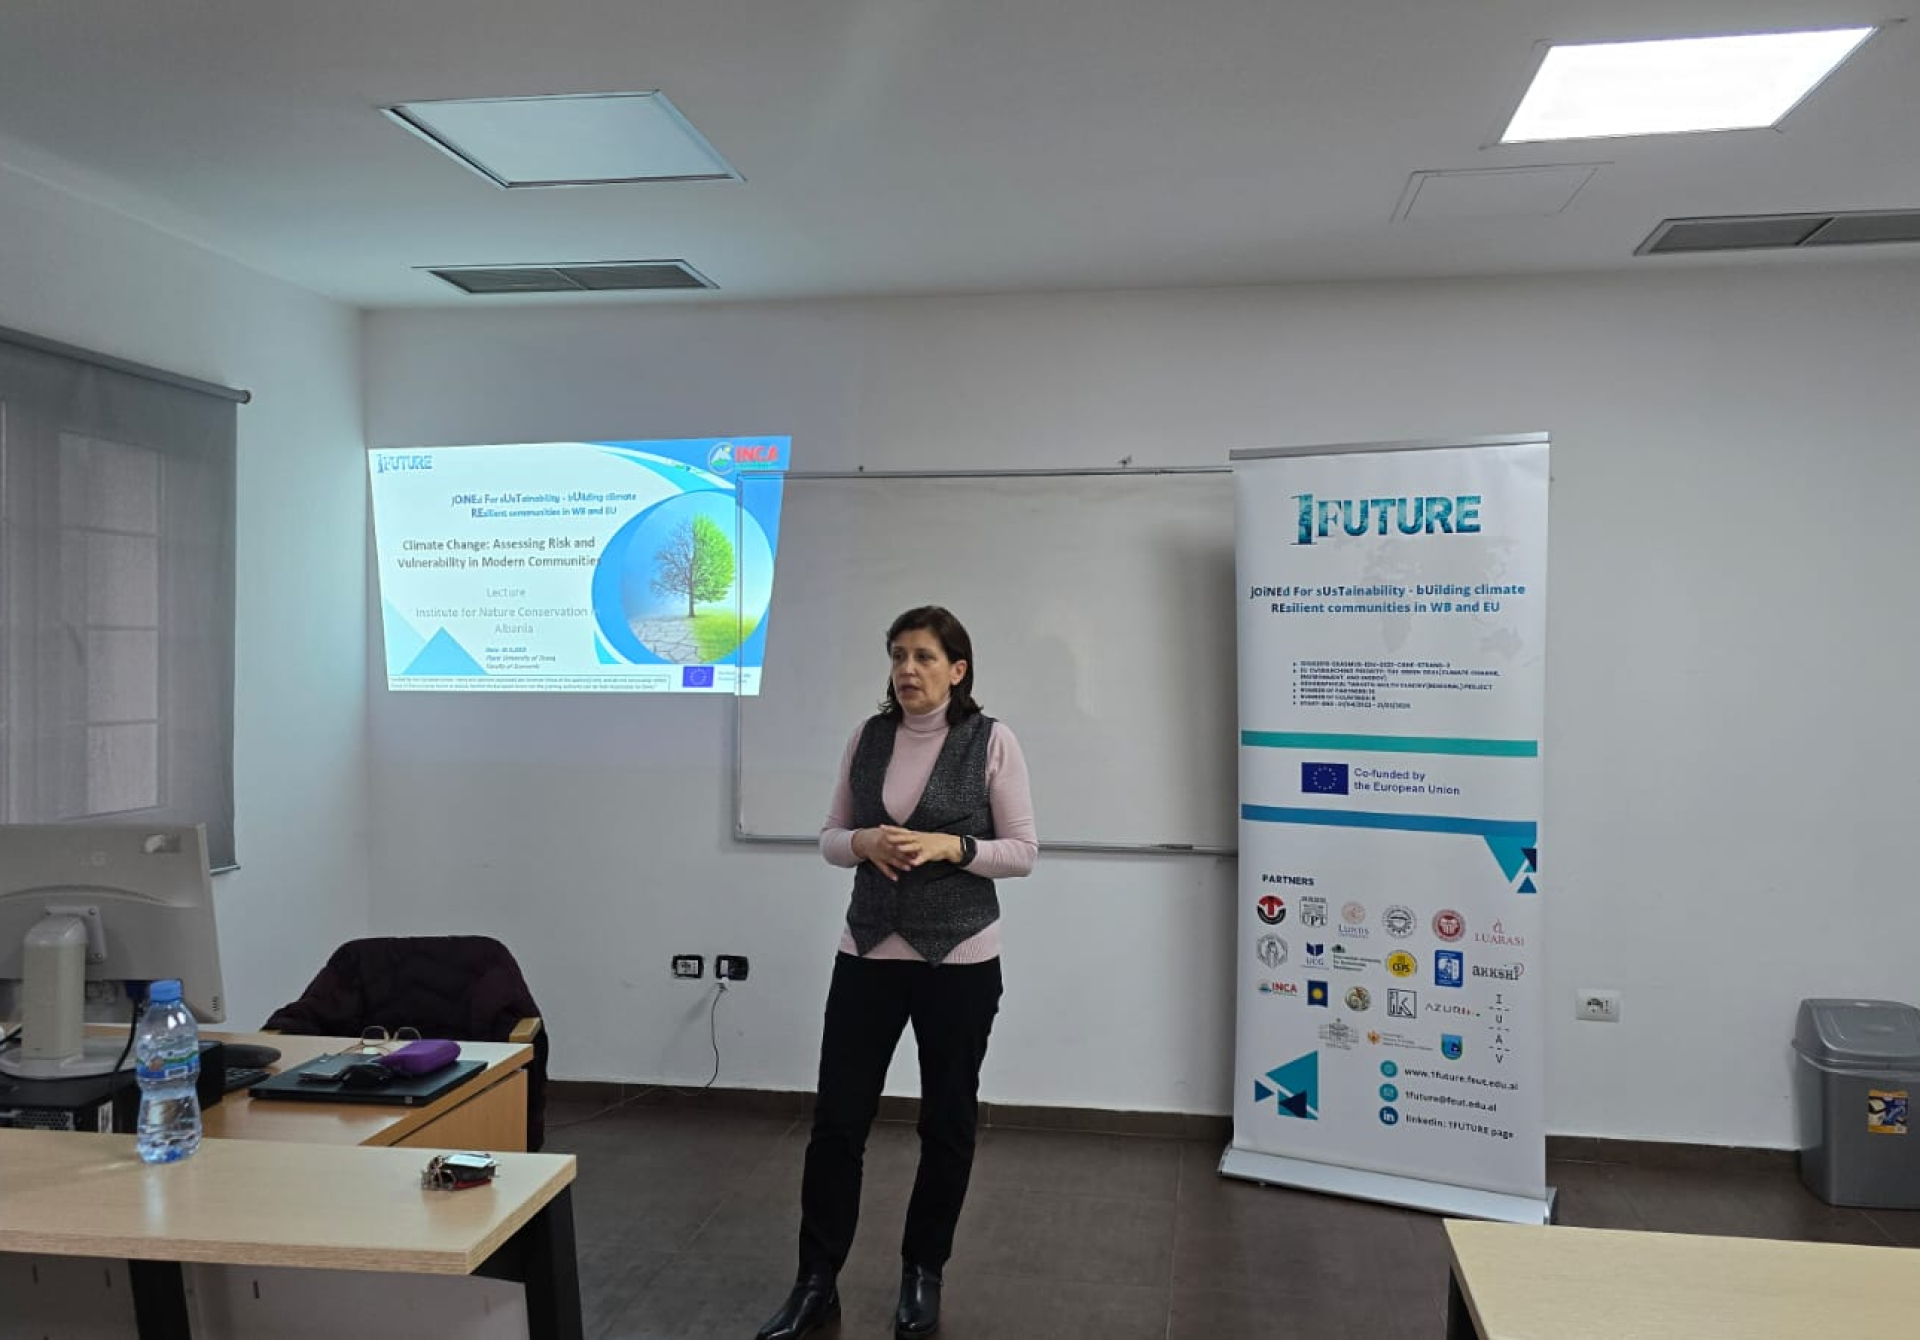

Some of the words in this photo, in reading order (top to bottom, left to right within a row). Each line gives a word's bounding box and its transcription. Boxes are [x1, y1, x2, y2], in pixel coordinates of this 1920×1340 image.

[735, 445, 777, 462] INCA
[1290, 494, 1481, 545] 1FUTURE
[402, 540, 444, 551] Climate
[446, 539, 490, 552] Change:
[493, 538, 546, 551] Assessing
[549, 536, 571, 549] Risk
[574, 536, 595, 548] and
[397, 557, 467, 570] Vulnerability
[469, 556, 479, 567] in
[482, 556, 525, 568] Modern
[486, 588, 526, 598] Lecture
[1294, 586, 1313, 596] For
[1474, 584, 1526, 595] climate
[416, 606, 458, 617] Institute
[461, 606, 476, 617] for
[479, 606, 516, 617] Nature
[518, 606, 588, 617] Conservation
[1271, 602, 1324, 613] REsilient
[1328, 602, 1411, 613] communities
[1414, 602, 1427, 612] in
[1430, 602, 1452, 612] WB
[1455, 602, 1480, 612] and
[1483, 602, 1501, 612] EU
[495, 624, 534, 634] Albania
[1354, 767, 1409, 779] Co-funded
[1412, 770, 1426, 782] by
[1354, 781, 1371, 790] the
[1373, 781, 1425, 794] European
[1428, 784, 1460, 796] Union
[1262, 874, 1315, 887] PARTNERS
[1272, 982, 1298, 994] INCA
